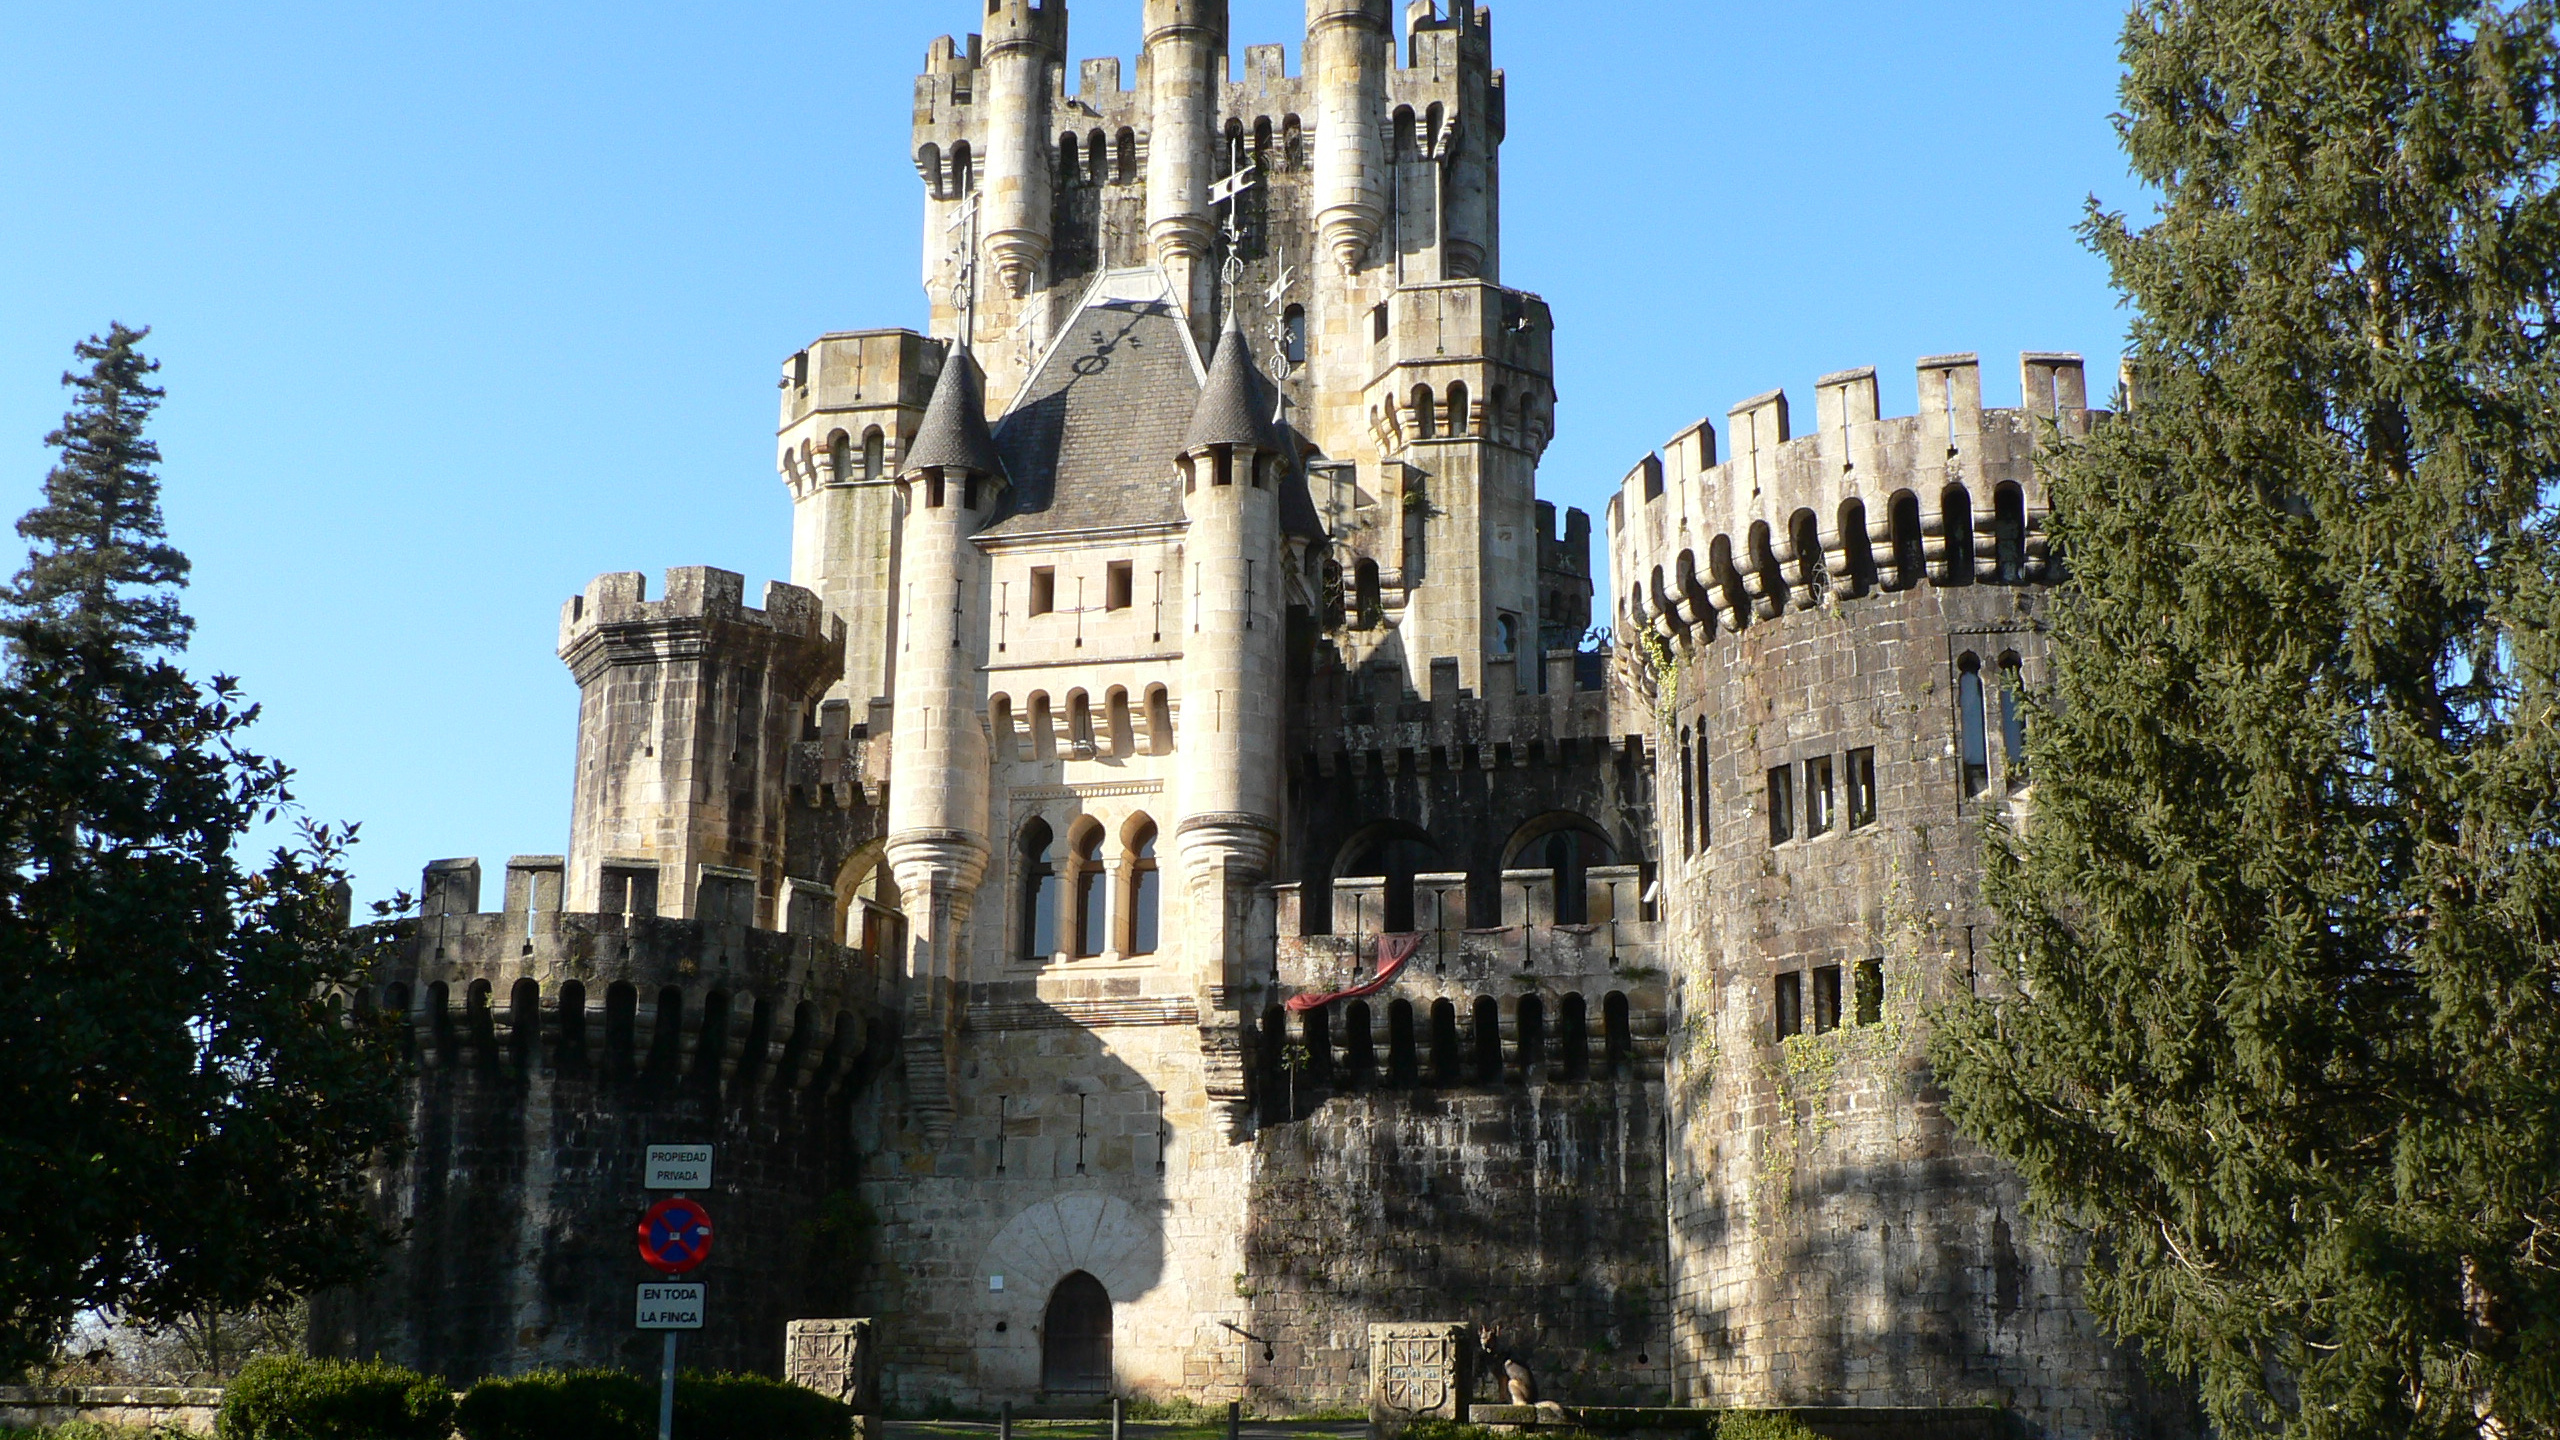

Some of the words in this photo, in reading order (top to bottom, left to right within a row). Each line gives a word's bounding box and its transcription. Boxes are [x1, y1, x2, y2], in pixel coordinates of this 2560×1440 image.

[651, 1152, 707, 1162] PROPIEDAD
[657, 1171, 698, 1181] PRIVADA
[644, 1289, 660, 1300] EN
[664, 1289, 697, 1300] TODA
[641, 1312, 657, 1323] LA
[660, 1312, 697, 1323] FINCA
